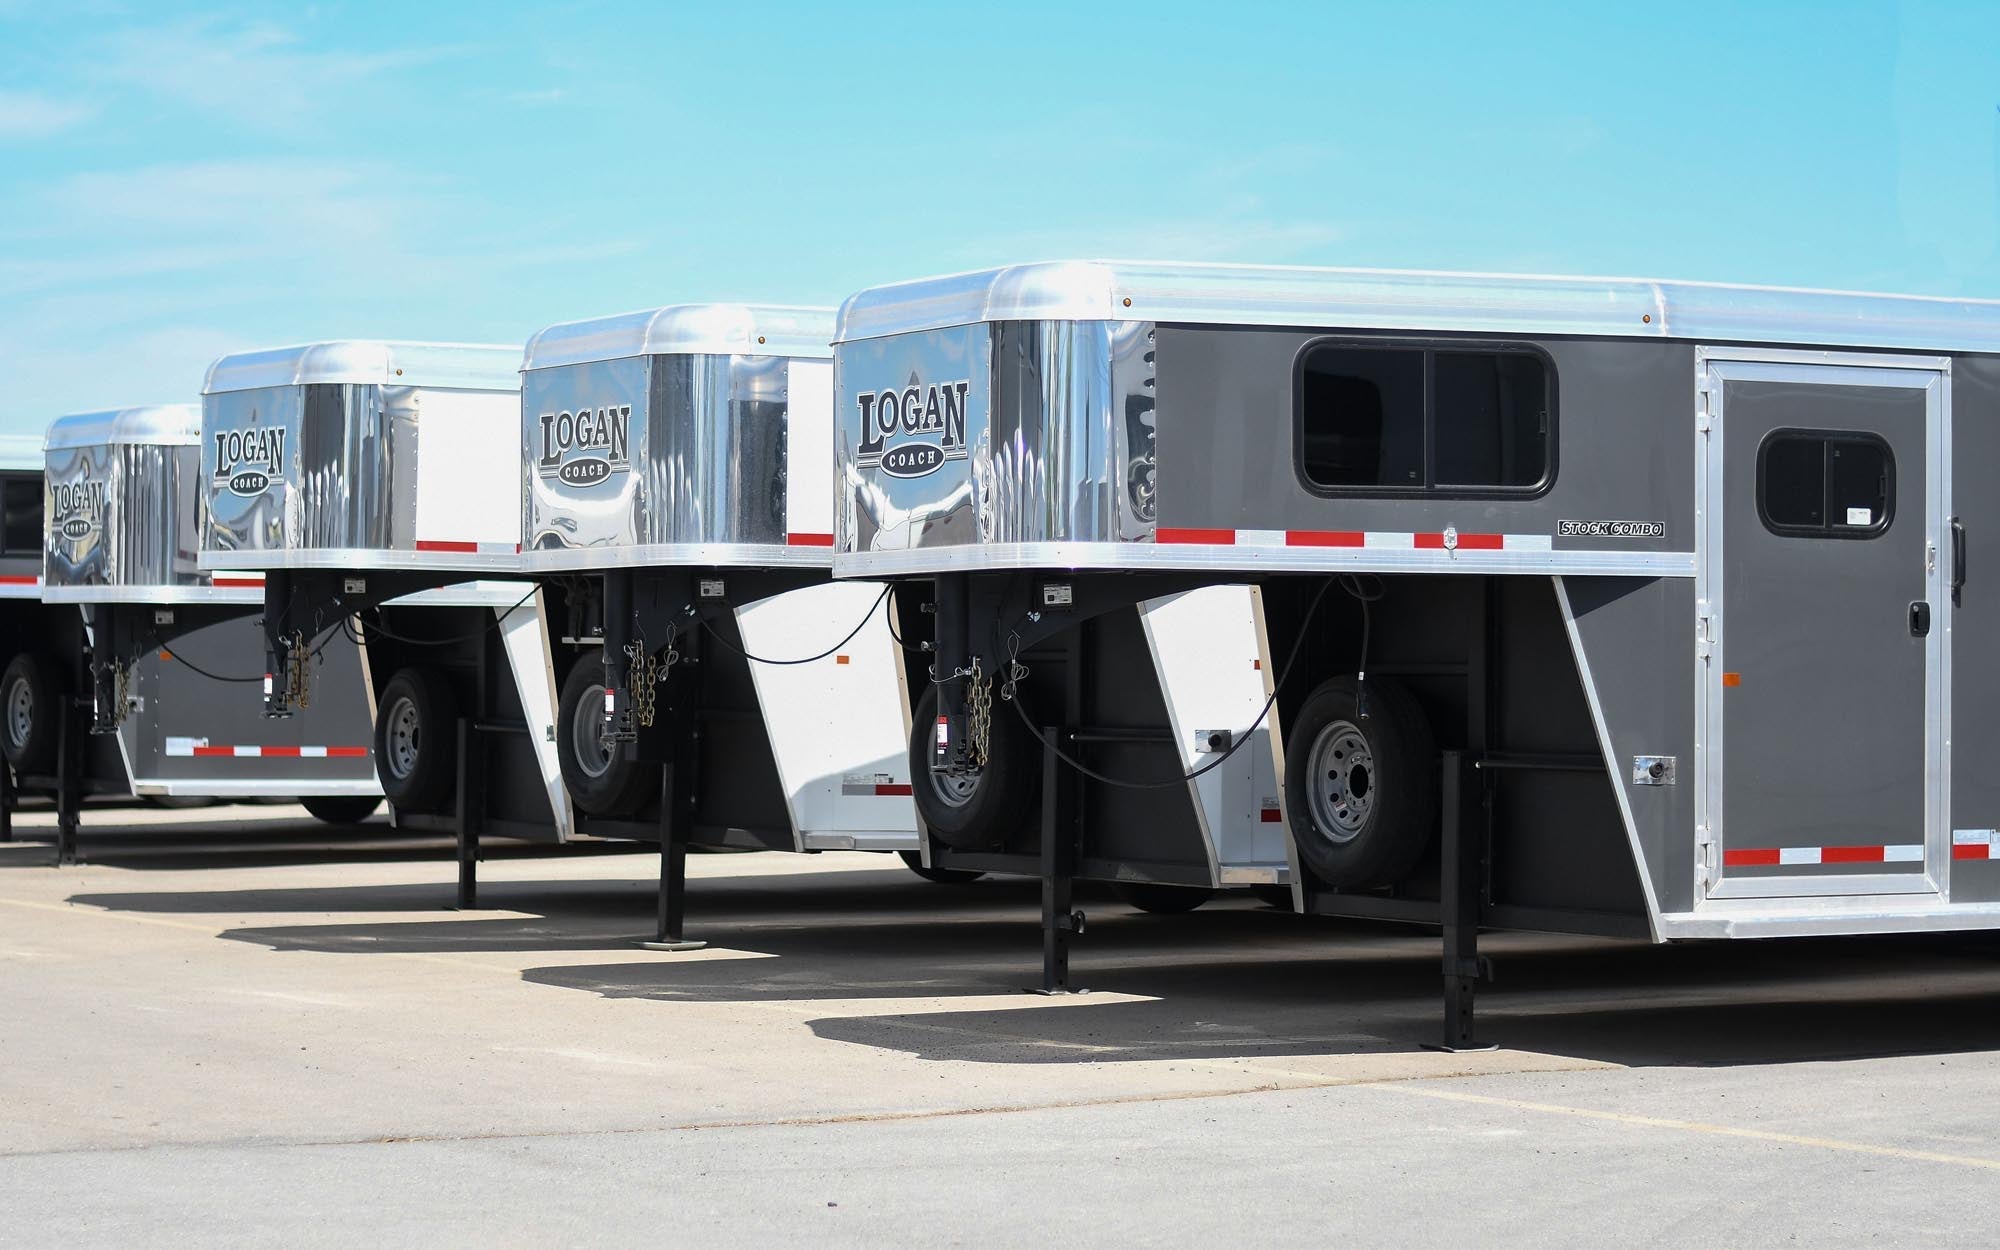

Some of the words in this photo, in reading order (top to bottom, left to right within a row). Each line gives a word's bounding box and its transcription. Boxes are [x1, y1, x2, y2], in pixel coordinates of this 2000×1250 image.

[857, 380, 969, 454] LOGAN
[540, 405, 630, 466] LOGAN
[214, 427, 286, 478] LOGAN
[888, 451, 936, 467] COACH
[565, 464, 604, 478] COACH
[233, 477, 264, 489] COACH
[52, 482, 103, 521] LOGAN
[65, 523, 89, 534] COACH
[1561, 521, 1609, 535] STOCK
[1611, 522, 1662, 536] COMBO
